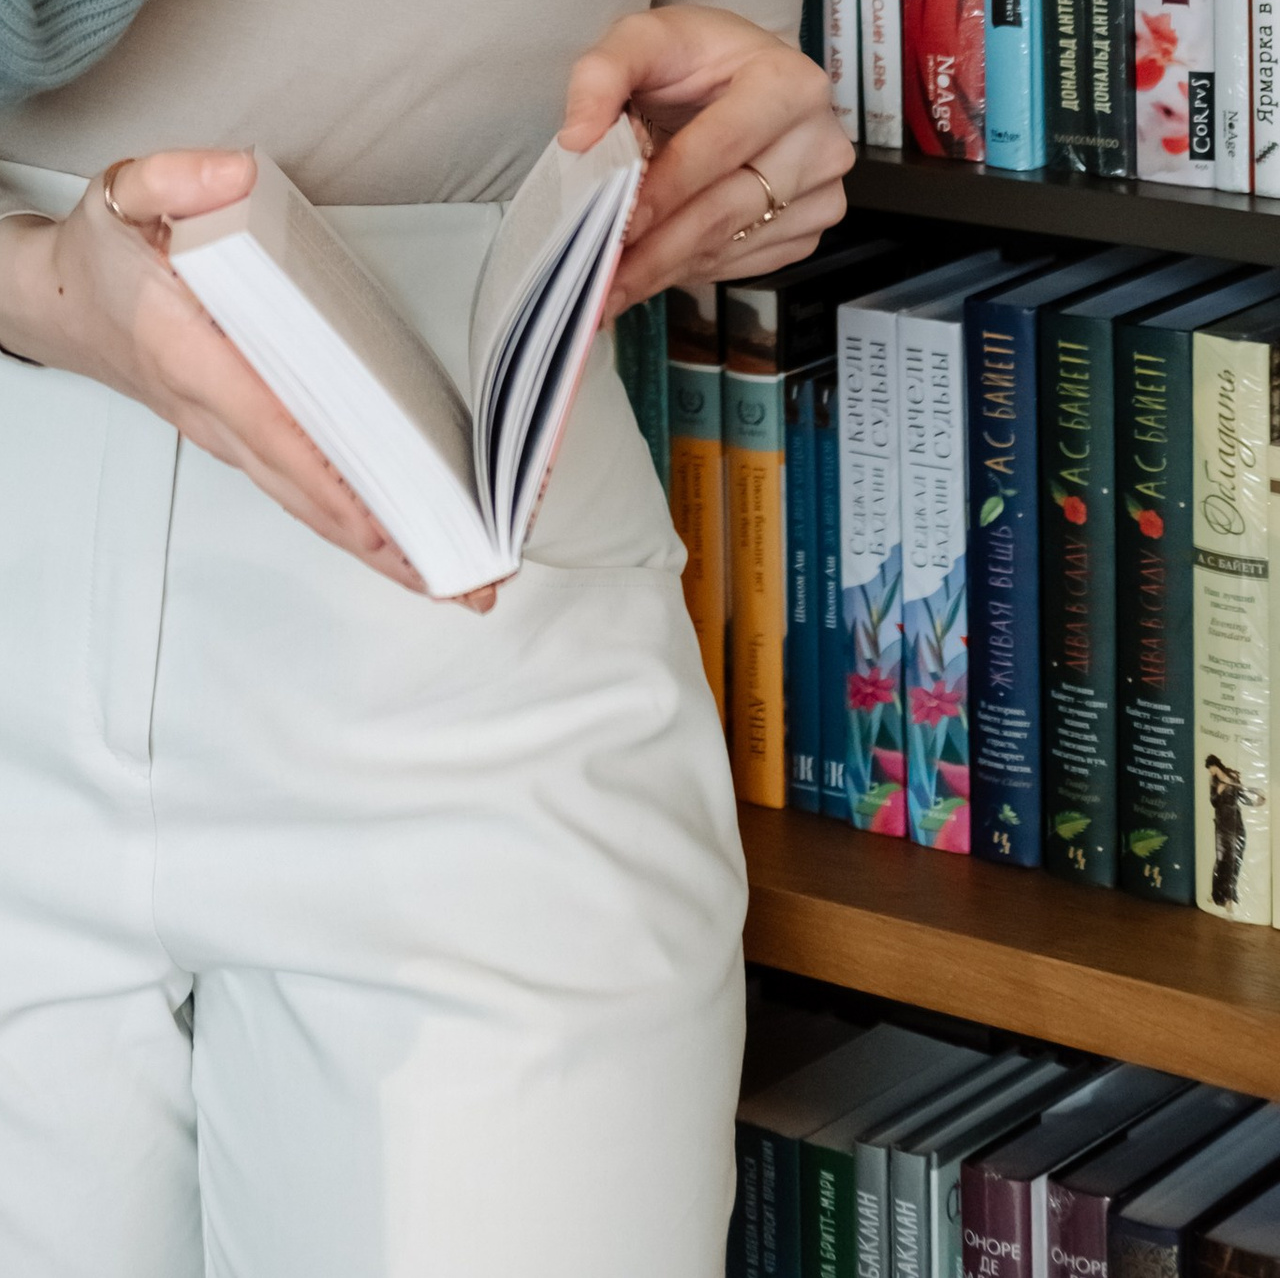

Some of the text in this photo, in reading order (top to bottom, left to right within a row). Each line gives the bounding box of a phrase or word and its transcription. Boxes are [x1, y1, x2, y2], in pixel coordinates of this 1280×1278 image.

[1260, 3, 1272, 15] в
[829, 46, 842, 84] ДЕНЬ
[872, 51, 886, 91] ДЕНЬ
[1060, 37, 1080, 112] ДОНАЛЬД
[1093, 39, 1111, 114] ДОНАЛЬД
[1256, 25, 1279, 125] Ярмарка
[932, 55, 954, 132] NoAge
[1225, 111, 1238, 158] NoAge
[981, 330, 1016, 420] БАЙЕТТ
[1056, 339, 1091, 431] БАЙЕТТ
[1131, 351, 1168, 443] БАЙЕТТ
[1199, 369, 1254, 536] Обладать
[794, 551, 805, 573] Аш
[825, 555, 836, 578] Аш
[987, 525, 1013, 589] ВЕЩЬ
[1064, 535, 1090, 596] САДУ
[1140, 549, 1165, 612] САДУ
[794, 575, 806, 623] Шолом
[825, 581, 837, 629] Шолом
[1066, 604, 1089, 614] В
[1142, 619, 1165, 629] В
[989, 602, 1014, 689] ЖИВАЯ
[1064, 623, 1090, 675] ДЕВА
[1140, 638, 1165, 690] ДЕВА
[820, 1169, 836, 1260] БРИТТ-МАРИ
[857, 1191, 880, 1278] БАКМАН
[896, 1198, 919, 1278] АКМАН
[964, 1229, 1021, 1262] ОНОРЕ
[980, 1256, 999, 1277] ДЕ
[1051, 1247, 1108, 1278] ОНОРЕ
